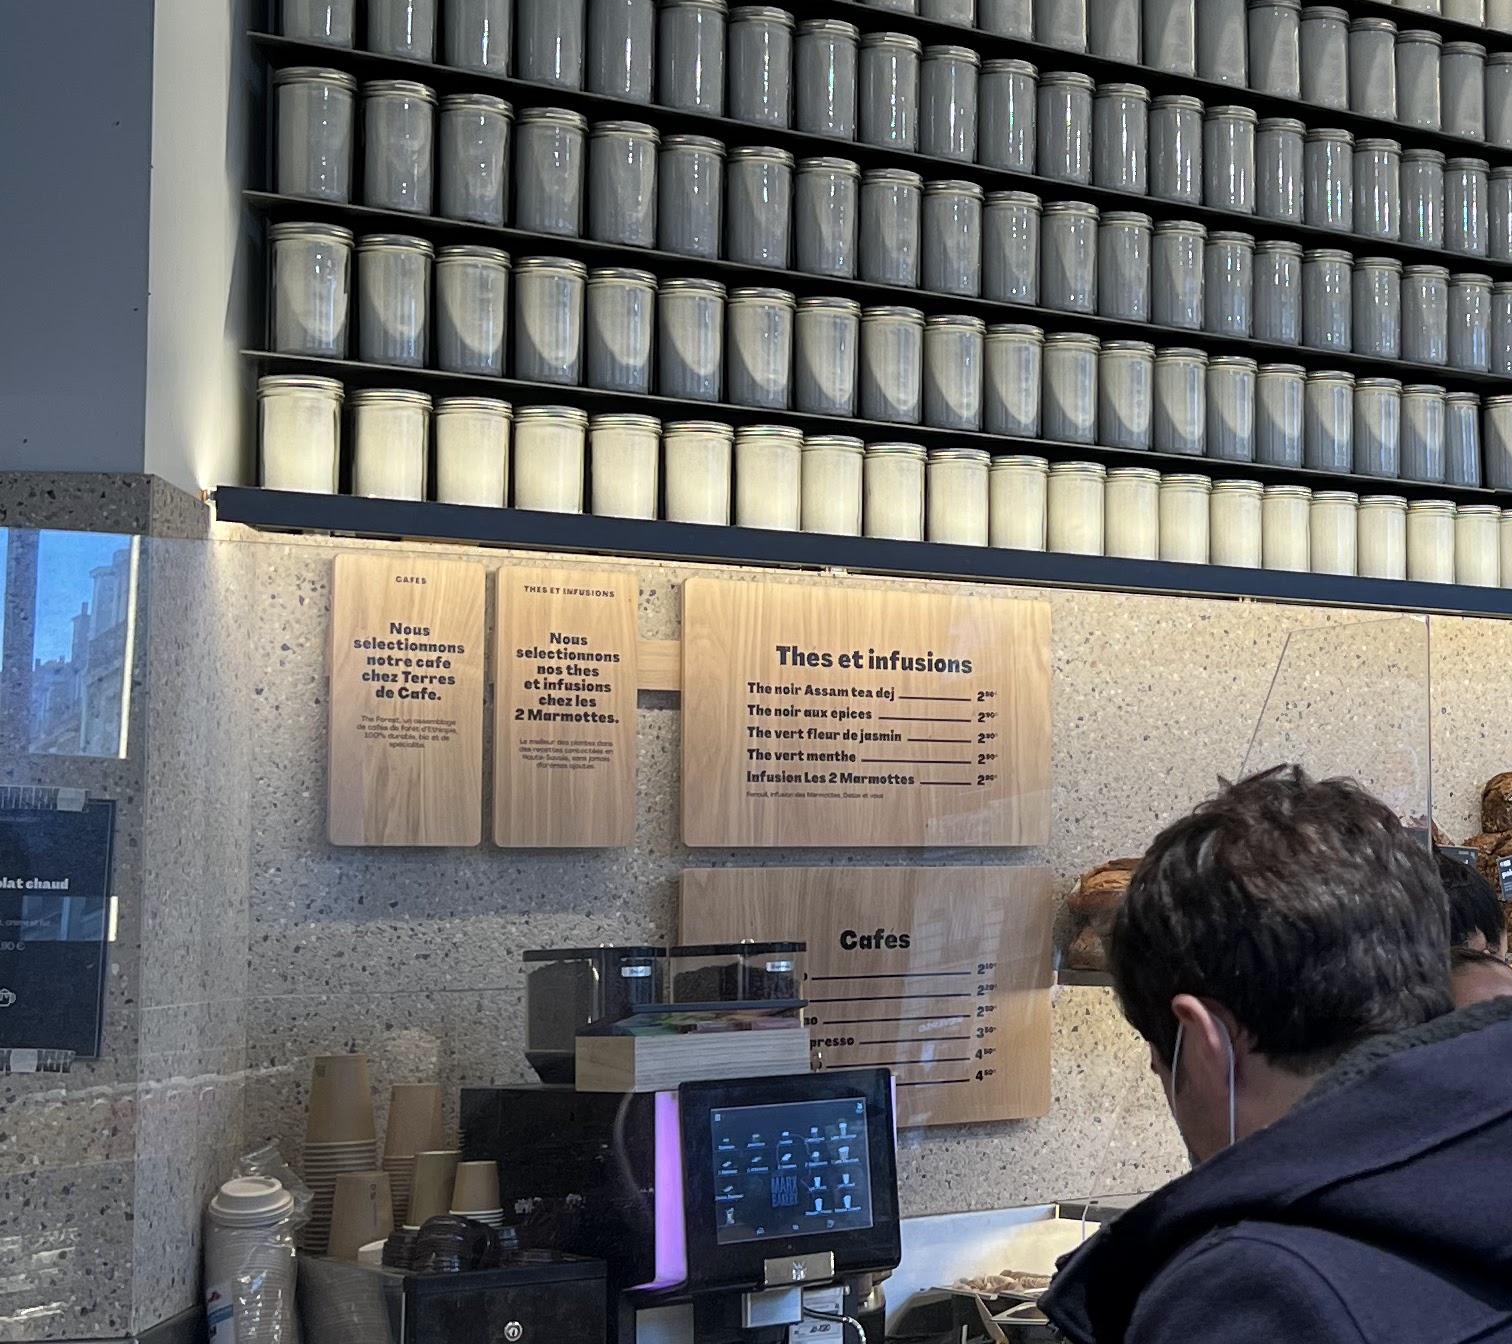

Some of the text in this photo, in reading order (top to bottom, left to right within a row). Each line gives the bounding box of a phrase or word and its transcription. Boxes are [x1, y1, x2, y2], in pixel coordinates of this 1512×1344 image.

[549, 587, 560, 595] ET
[562, 587, 615, 598] INFUSIONS
[389, 622, 430, 636] Nous
[550, 632, 588, 646] Nous
[366, 655, 412, 667] notre
[838, 650, 863, 669] et
[868, 648, 973, 674] infusions
[361, 669, 456, 685] chez Terres
[537, 665, 563, 675] nos
[524, 677, 612, 693] et infusions
[775, 683, 801, 695] noir
[804, 684, 849, 697] Assam
[851, 687, 874, 699] tea
[375, 686, 394, 699] de
[538, 694, 597, 707] chez les
[514, 708, 620, 724] 2 Marmottes.
[775, 704, 801, 717] noir
[803, 708, 827, 718] aux
[775, 728, 804, 740] vert
[807, 728, 840, 741] fleur
[842, 729, 858, 741] de
[858, 729, 902, 744] jasmin
[775, 750, 804, 762] vert
[806, 750, 856, 762] menthe
[746, 771, 915, 785] Infusion Les 2 Marmottes
[25, 878, 69, 890] chaud
[810, 1037, 855, 1050] presso
